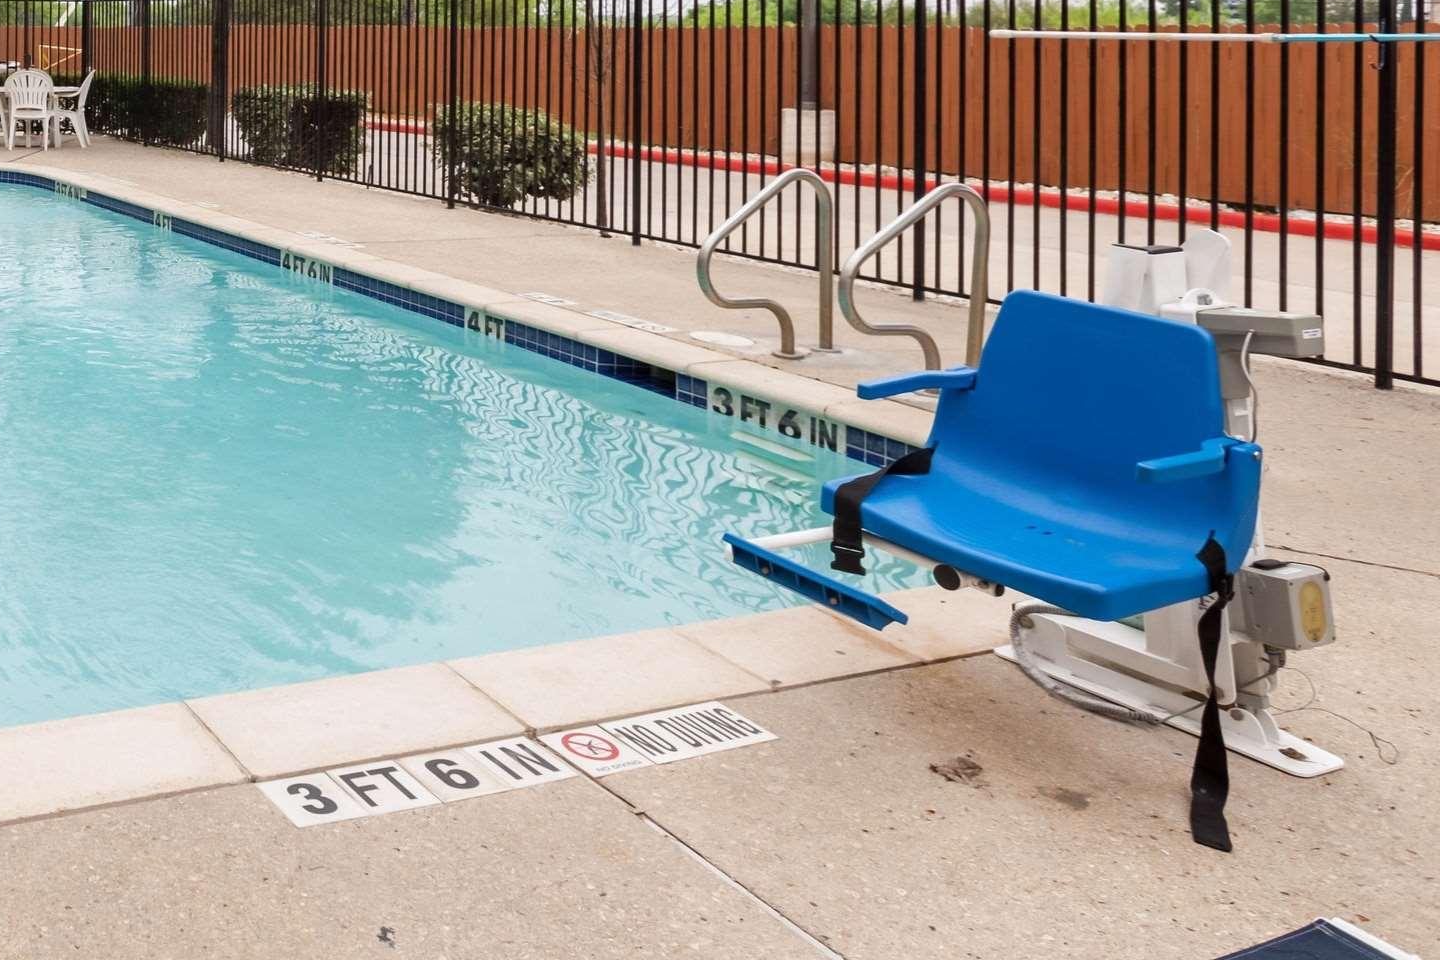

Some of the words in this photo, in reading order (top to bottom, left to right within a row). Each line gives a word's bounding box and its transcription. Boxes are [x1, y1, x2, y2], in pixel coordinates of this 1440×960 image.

[156, 211, 162, 226] 4
[162, 214, 172, 230] FT
[282, 250, 292, 271] 4
[293, 256, 305, 276] FT
[307, 257, 317, 279] 6
[319, 264, 331, 284] IN
[467, 311, 480, 333] 4
[485, 315, 504, 340] FT
[712, 386, 734, 417] 3
[740, 394, 771, 429] FT
[777, 409, 802, 439] 6
[810, 416, 838, 452] IN
[613, 724, 678, 757] NO
[654, 707, 764, 748] DIVING
[286, 781, 339, 816] 3
[338, 765, 418, 808] FT
[423, 757, 481, 790] 6
[480, 742, 560, 781] IN
